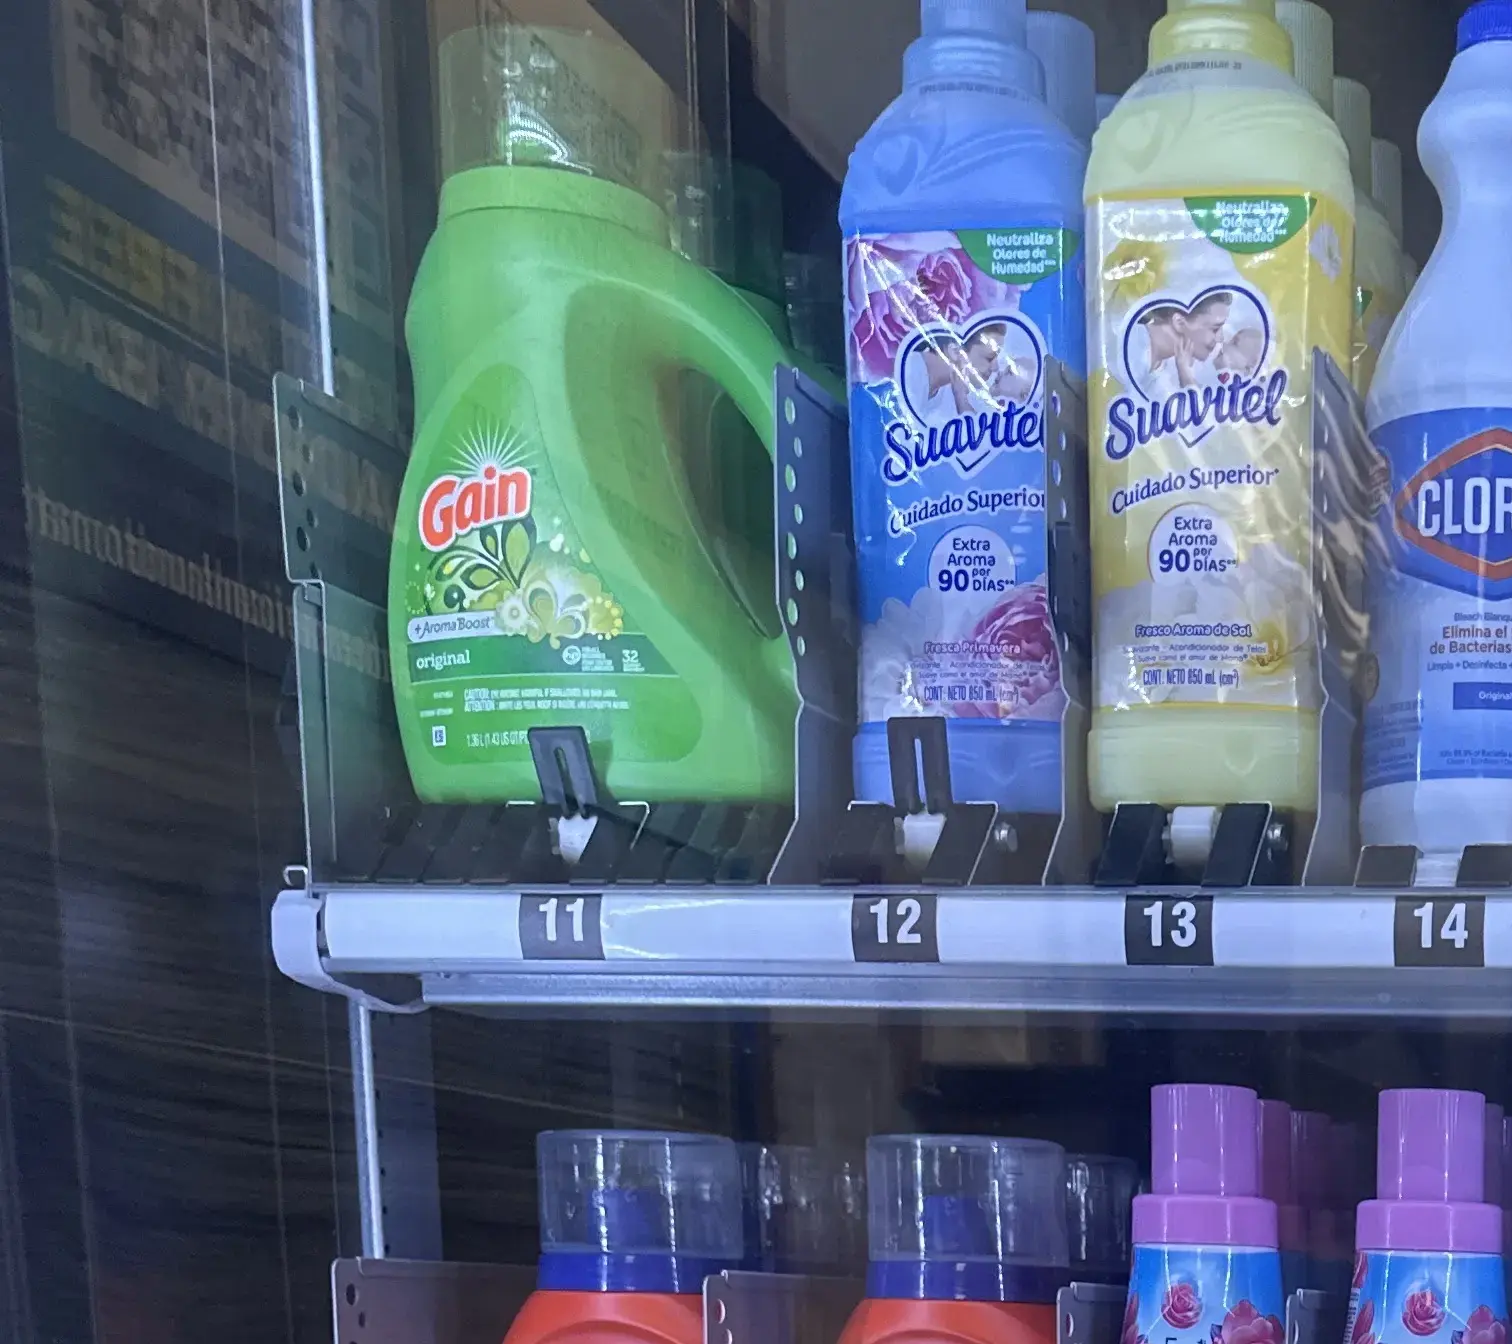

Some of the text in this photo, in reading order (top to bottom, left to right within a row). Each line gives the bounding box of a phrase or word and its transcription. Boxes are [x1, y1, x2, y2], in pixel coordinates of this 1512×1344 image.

[986, 233, 1054, 246] Neutraliza
[993, 247, 1047, 259] Olores de
[1106, 370, 1288, 460] Suavitel
[884, 400, 1044, 483] Suavite
[1112, 475, 1185, 514] Cuidado
[419, 463, 531, 551] Gain
[889, 493, 963, 534] Cuidado
[1174, 517, 1213, 531] Extra
[952, 537, 991, 551] Extra
[1168, 532, 1218, 546] Aroma
[947, 553, 996, 567] Aroma
[1158, 549, 1190, 572] 90
[1193, 547, 1213, 559] por
[938, 569, 969, 592] 90
[972, 568, 991, 581] por
[1135, 624, 1252, 637] Fresco Aroma de Sol
[1442, 626, 1492, 640] Elimina
[1495, 626, 1508, 639] el
[924, 642, 1021, 655] Fresca Primavera
[1429, 641, 1446, 655] de
[1449, 640, 1512, 655] Bacterias
[416, 650, 471, 671] original
[1479, 690, 1512, 702] Original
[539, 897, 585, 943] 11
[869, 897, 921, 944] 12
[1143, 901, 1197, 948] 13
[1413, 902, 1469, 949] 14
